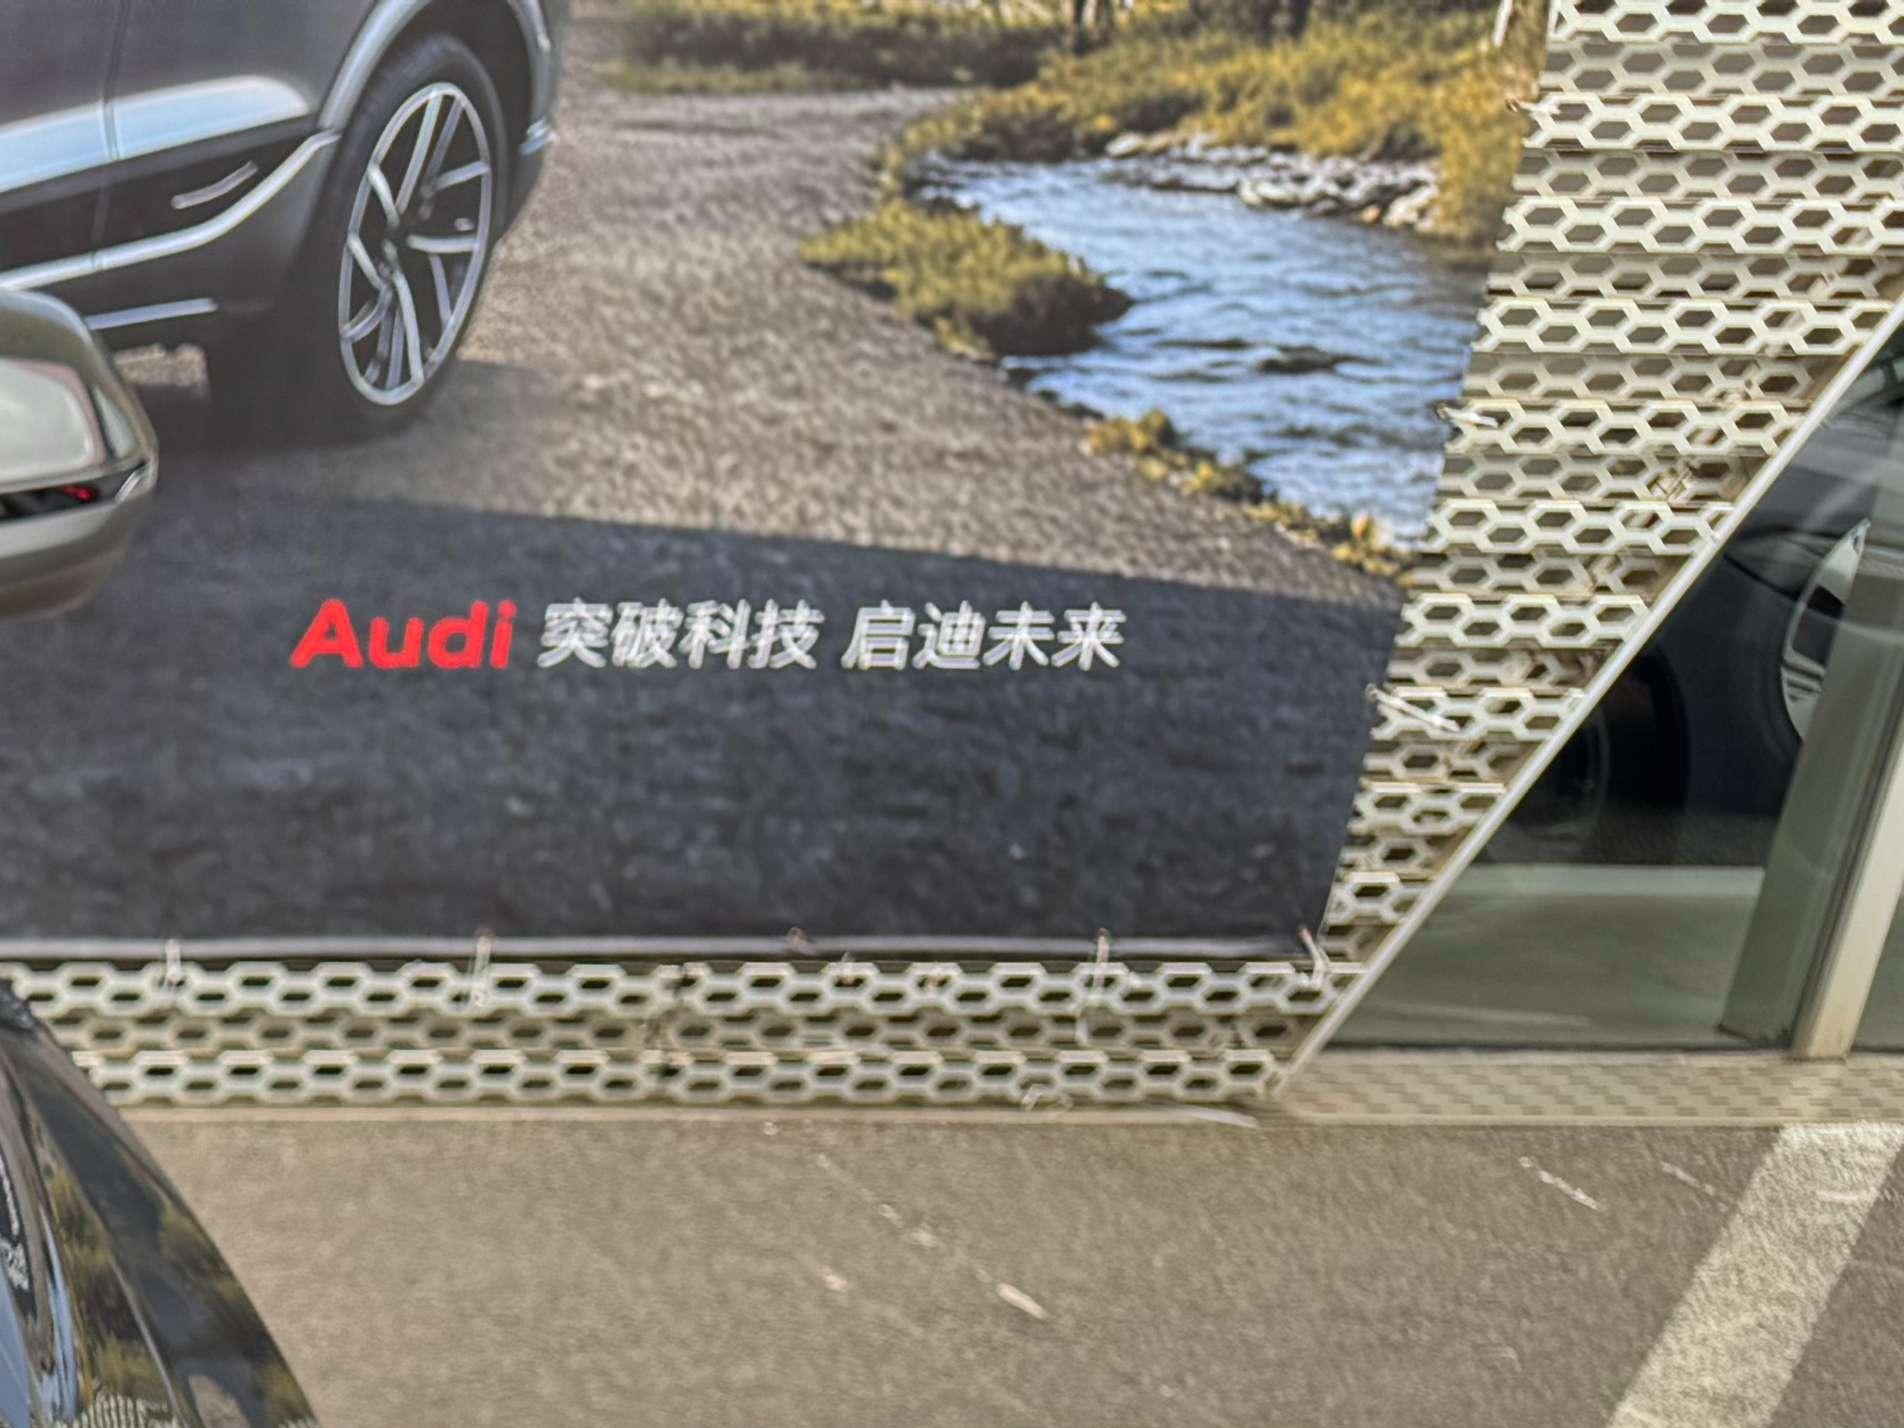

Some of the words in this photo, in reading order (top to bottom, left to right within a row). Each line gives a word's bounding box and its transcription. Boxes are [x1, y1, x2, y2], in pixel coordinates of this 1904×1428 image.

[291, 599, 517, 669] Audi
[536, 597, 825, 670] 突破科技
[840, 599, 1128, 671] 启迪未来
